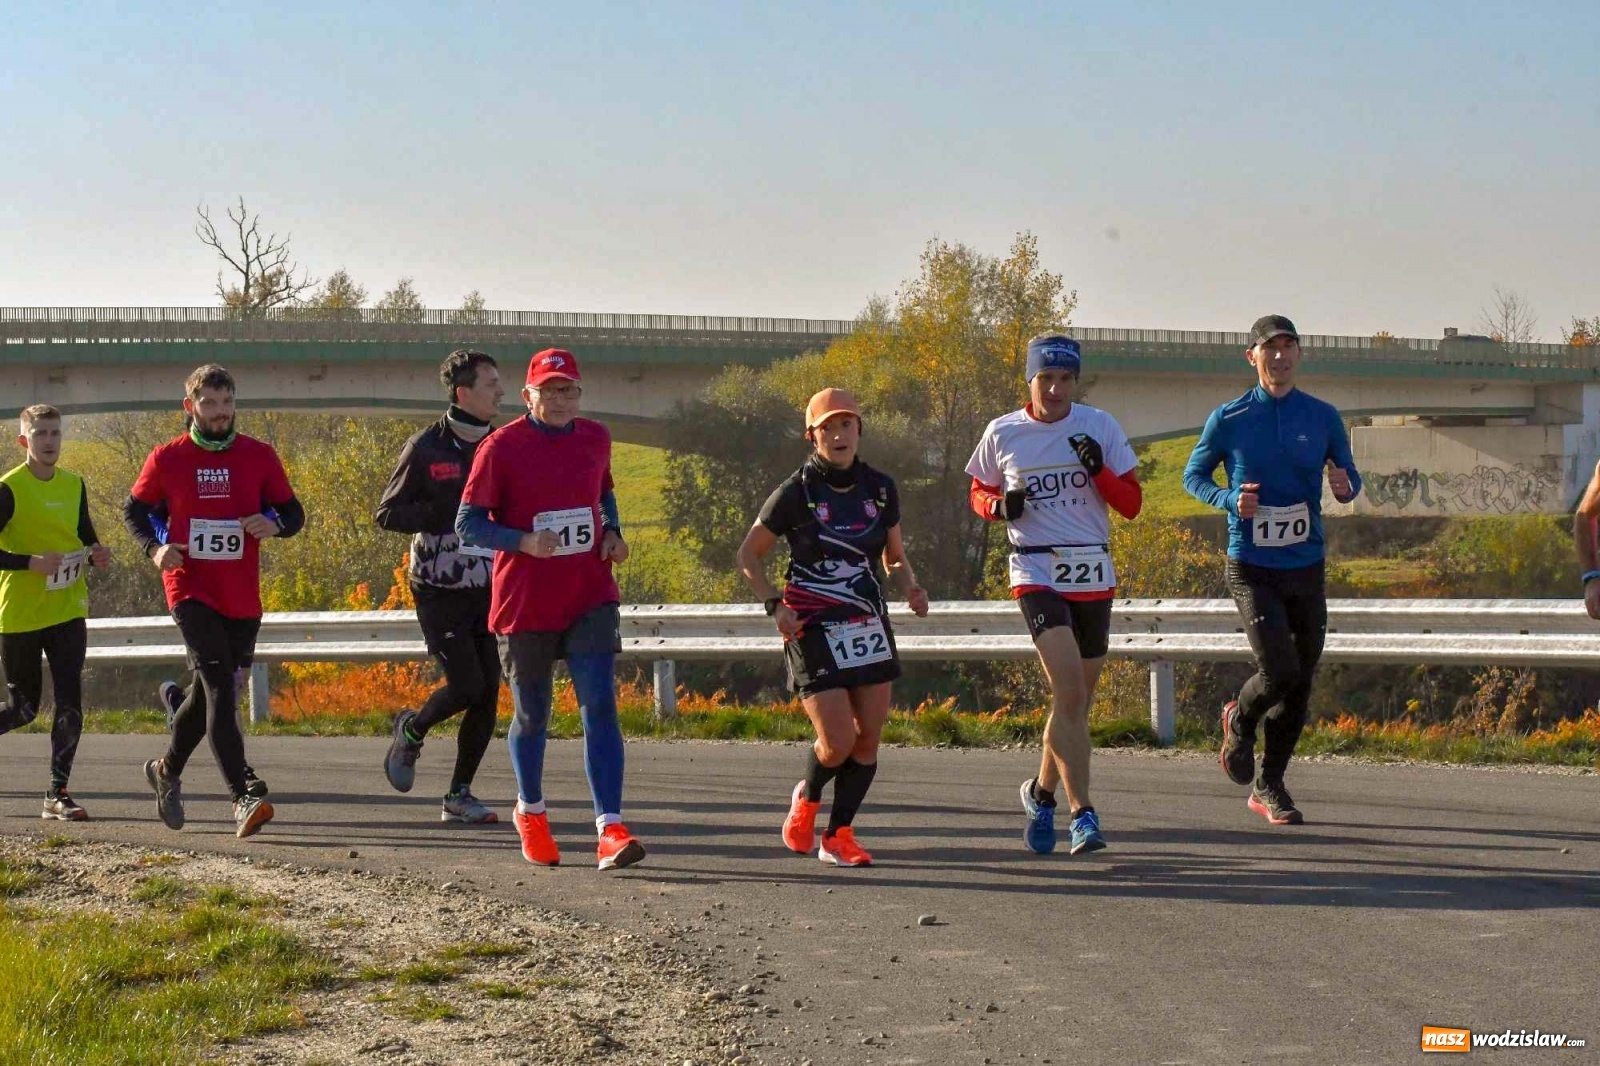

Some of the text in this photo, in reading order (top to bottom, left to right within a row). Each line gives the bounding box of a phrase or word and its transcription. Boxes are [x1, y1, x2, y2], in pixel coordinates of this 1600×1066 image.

[198, 482, 231, 493] RUN
[545, 524, 591, 547] 15
[1257, 518, 1306, 539] 170
[193, 533, 241, 553] 159
[1054, 562, 1104, 584] 221
[835, 632, 887, 660] 152
